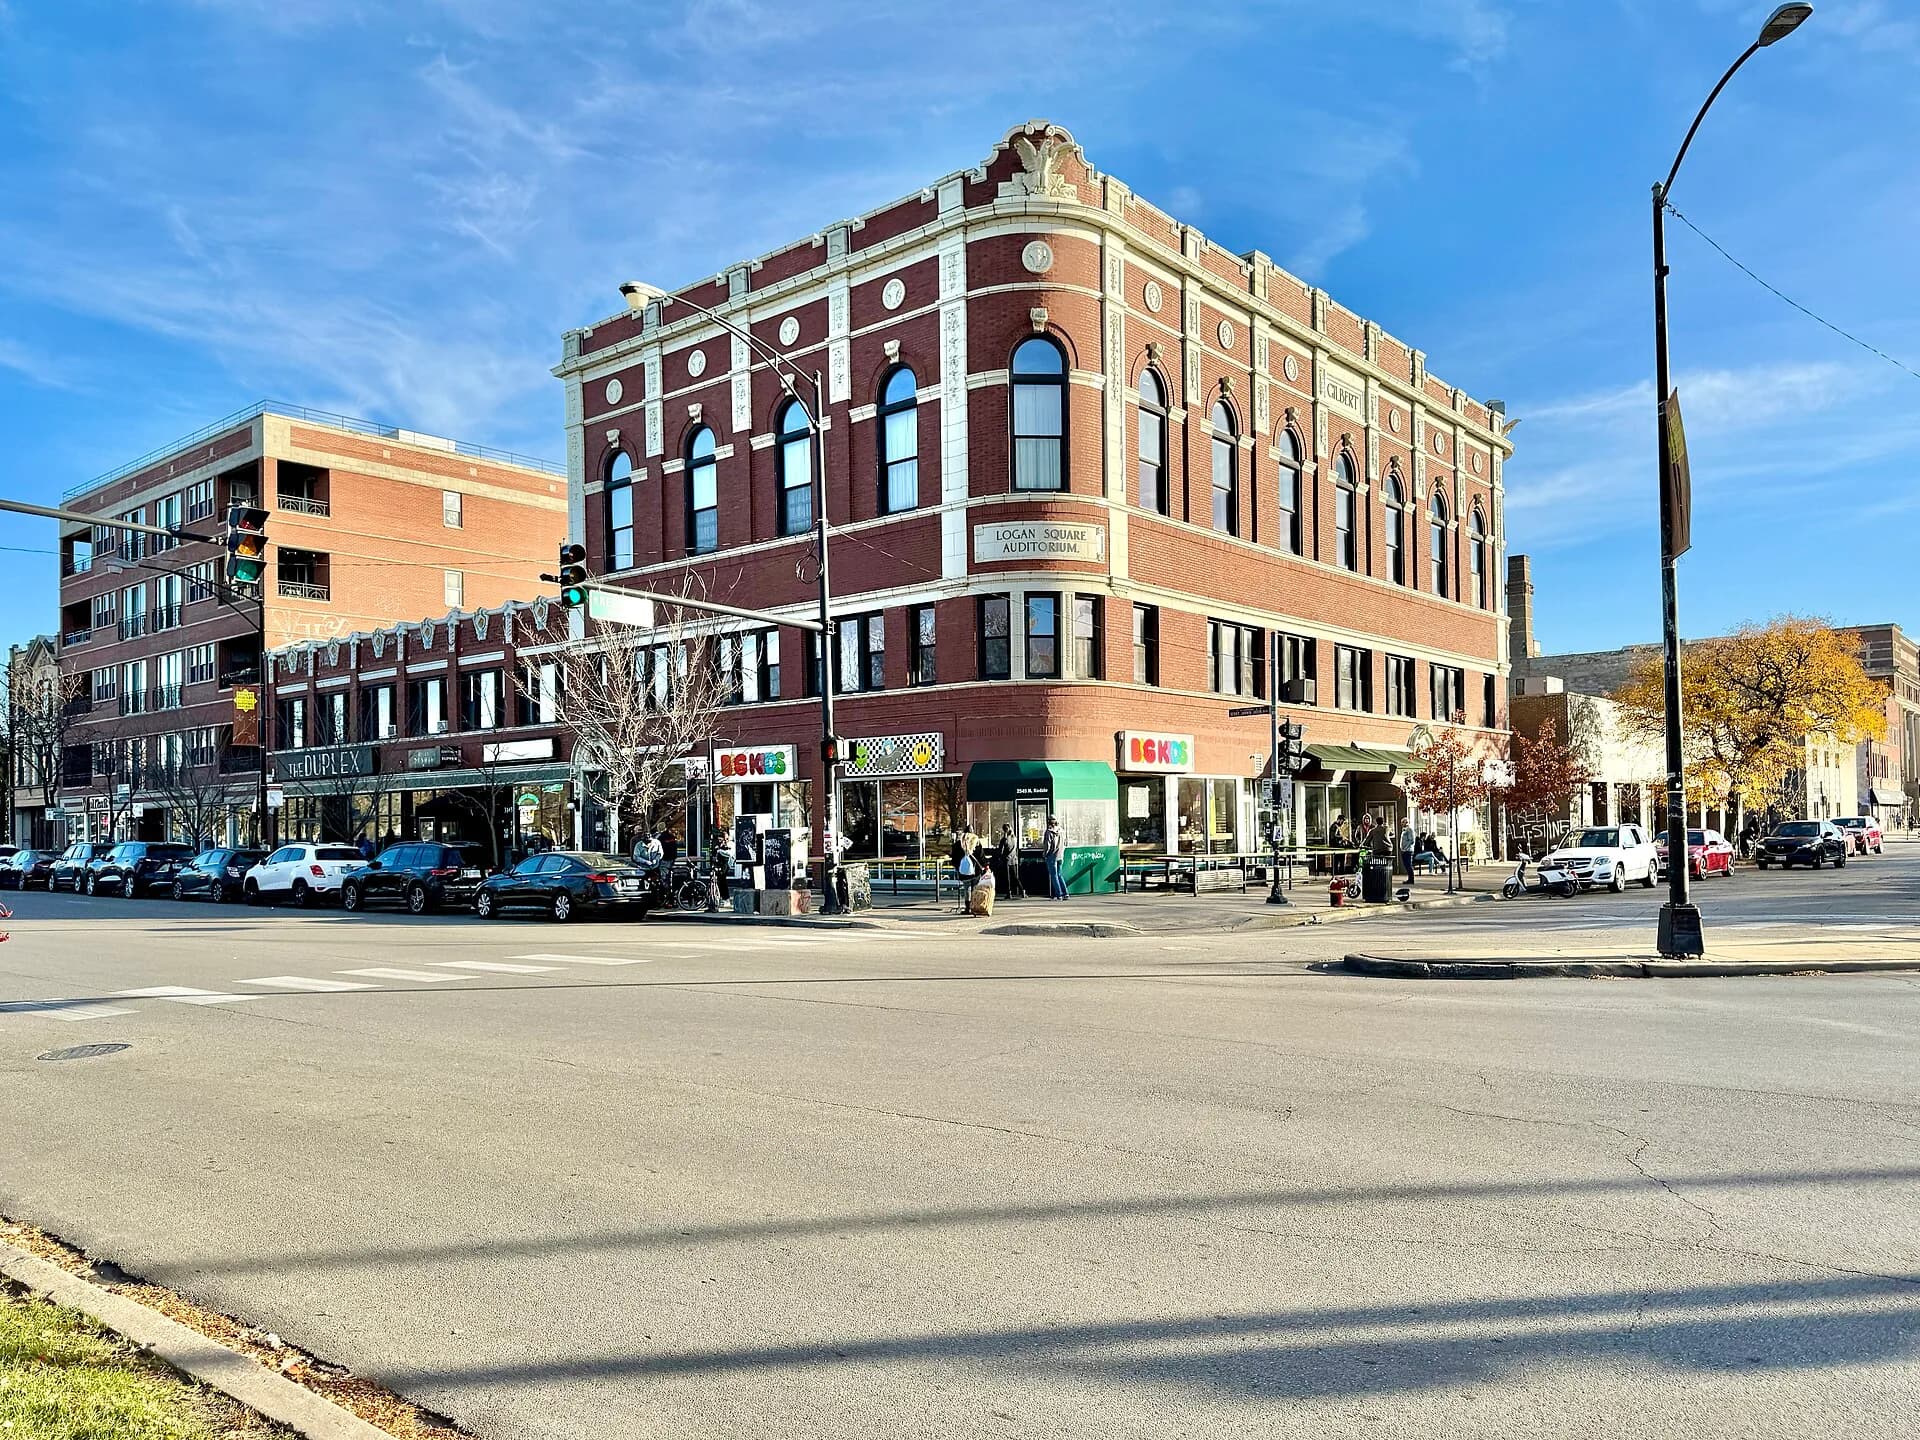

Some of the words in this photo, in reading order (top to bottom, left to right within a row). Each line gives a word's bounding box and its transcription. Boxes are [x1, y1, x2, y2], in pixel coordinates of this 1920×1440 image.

[1326, 383, 1359, 410] GILBERT
[996, 529, 1036, 541] LOGAN
[1044, 529, 1087, 541] SQUARE
[288, 762, 304, 778] THE
[304, 750, 360, 777] DUPLEX
[749, 751, 787, 776] KIDS
[1157, 739, 1188, 766] KIDS
